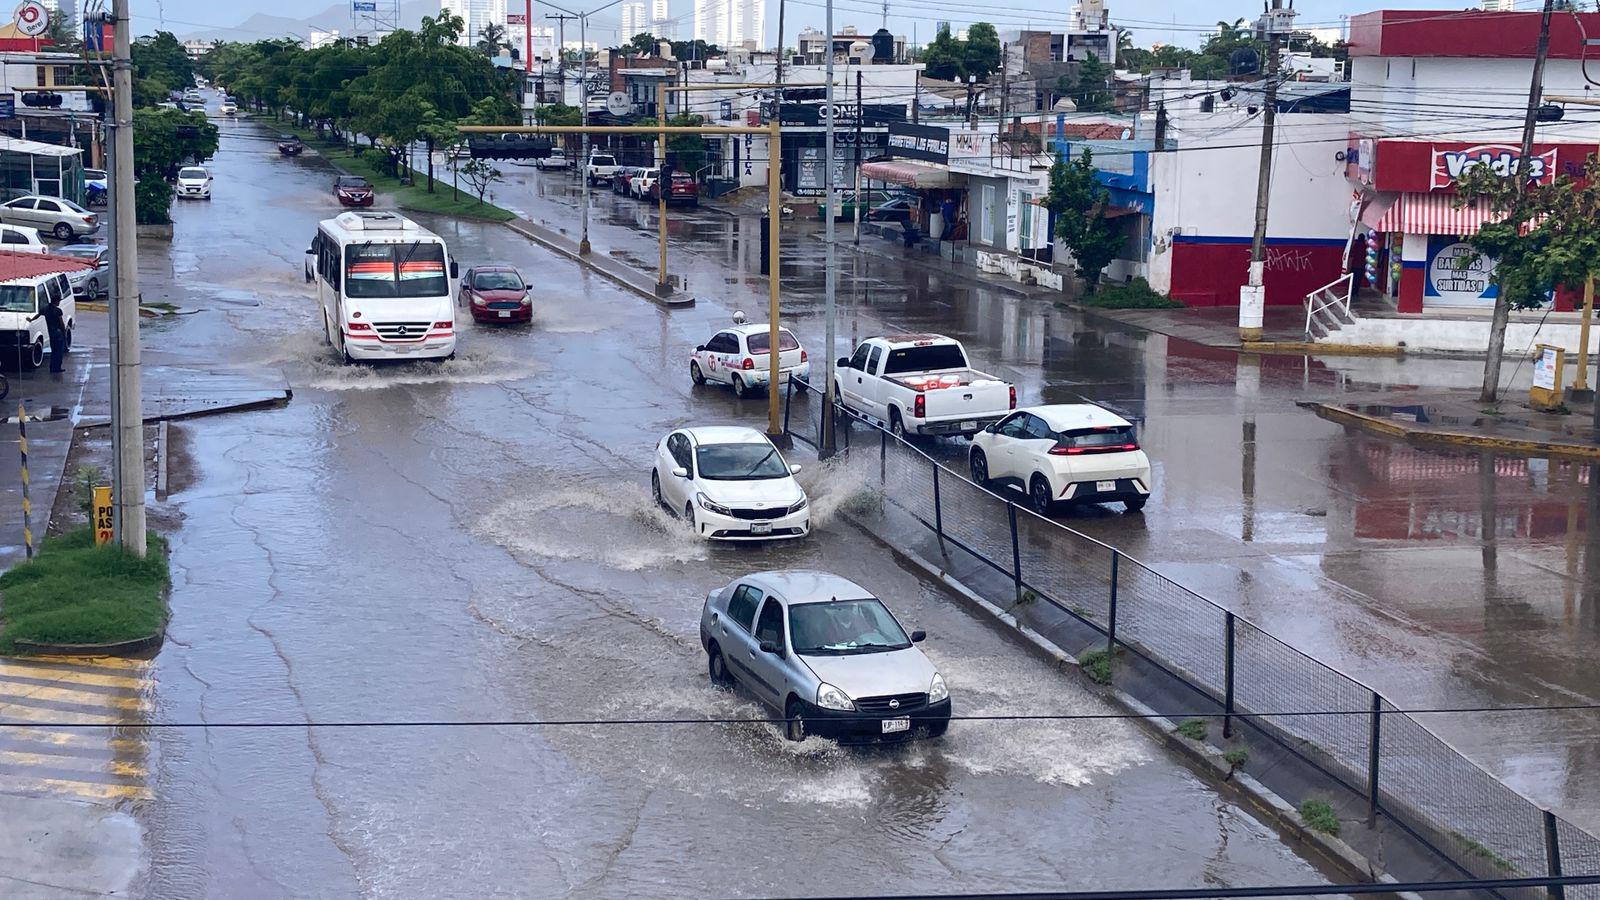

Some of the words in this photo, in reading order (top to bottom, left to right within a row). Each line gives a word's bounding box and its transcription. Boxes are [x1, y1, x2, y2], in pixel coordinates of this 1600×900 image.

[26, 19, 44, 33] Berel
[1437, 257, 1482, 270] BARAS
[1451, 271, 1467, 280] MAS
[1437, 279, 1476, 292] SURTIDAS
